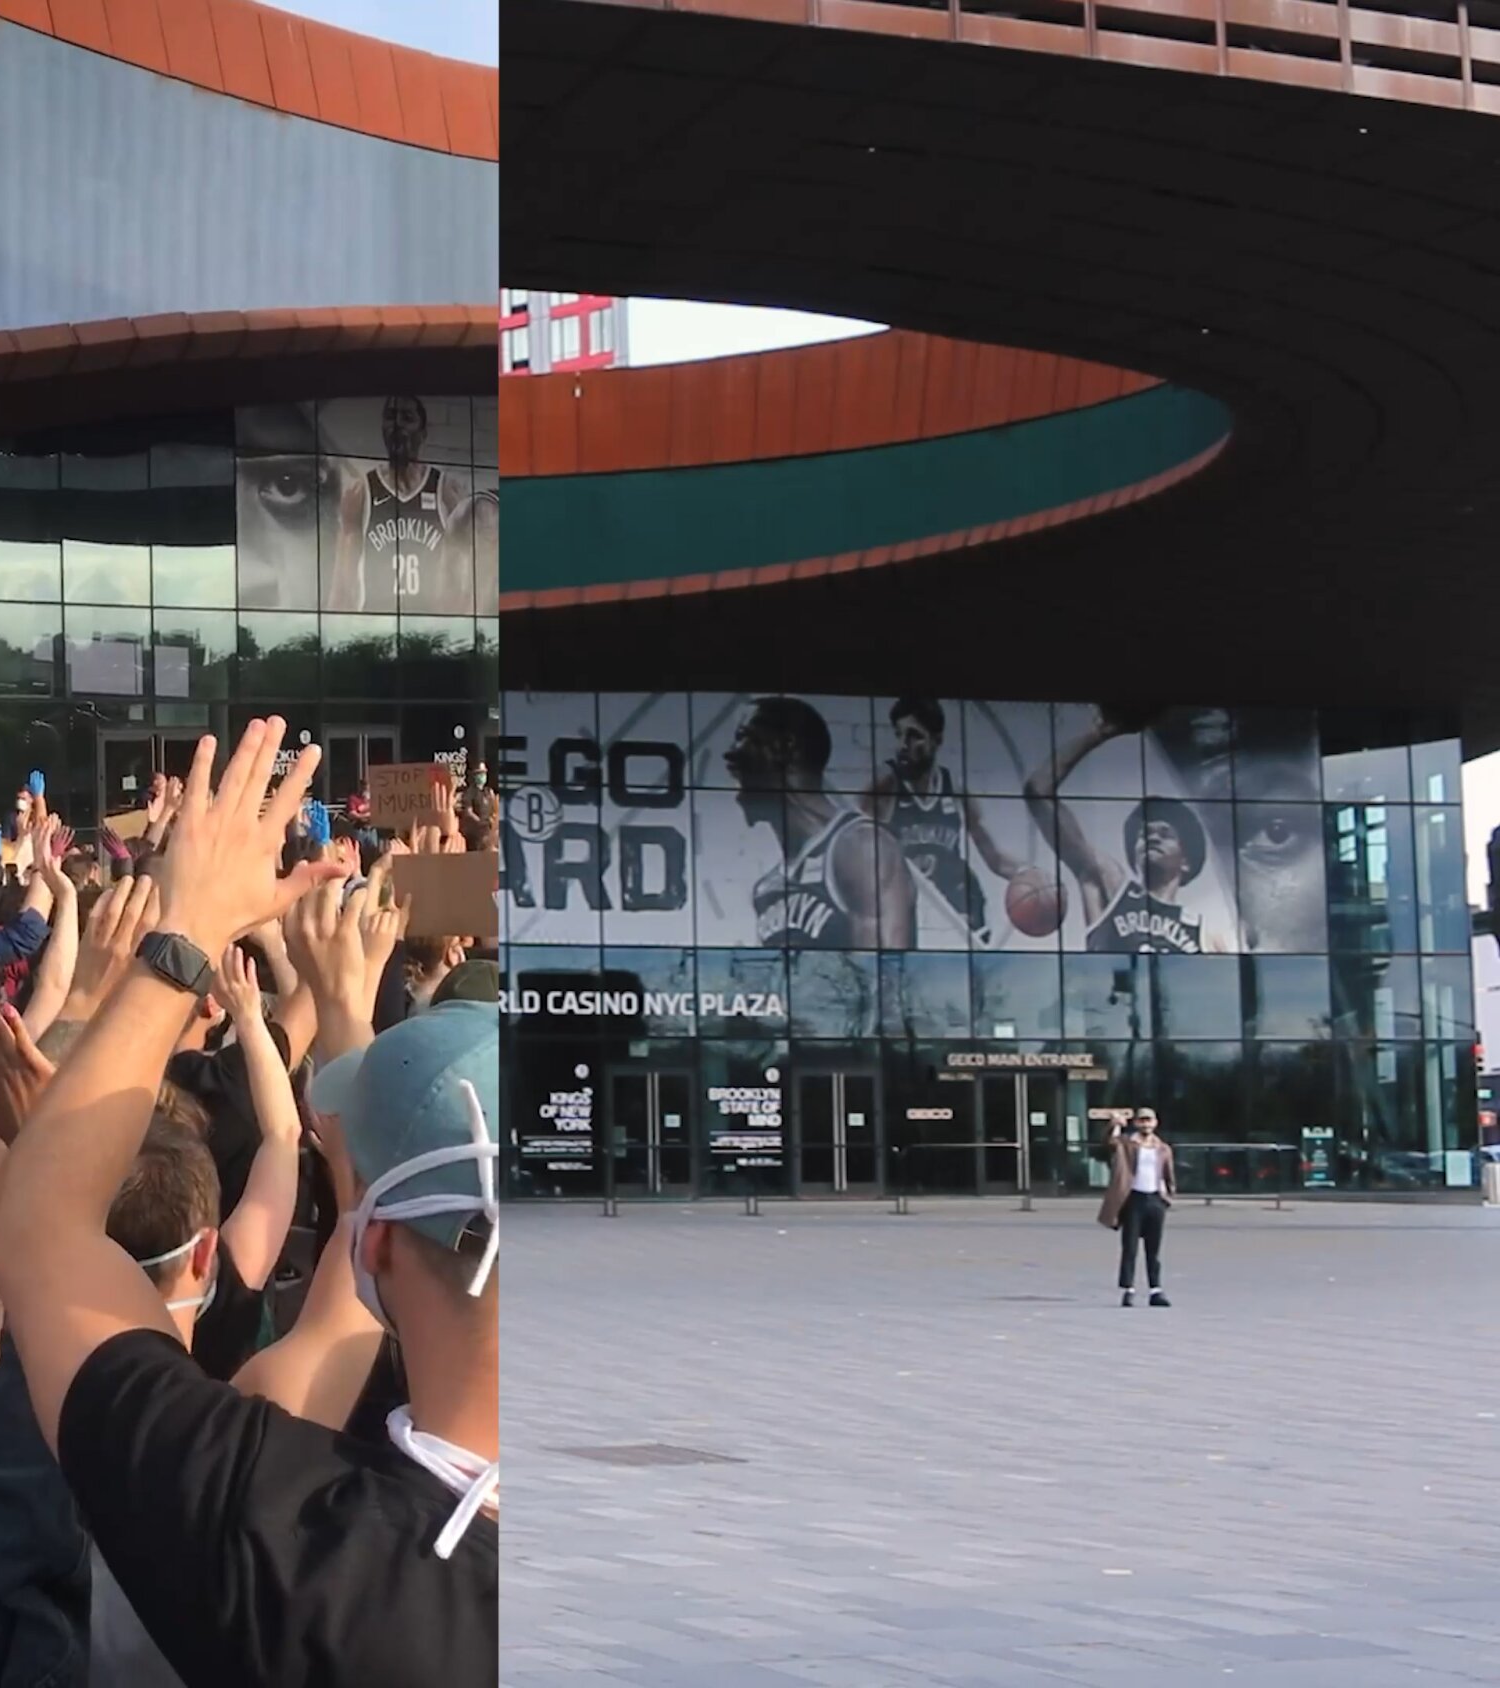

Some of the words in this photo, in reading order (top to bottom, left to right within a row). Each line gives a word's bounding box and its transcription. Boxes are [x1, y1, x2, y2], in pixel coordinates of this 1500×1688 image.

[368, 517, 442, 551] BROOKLYN
[392, 554, 420, 595] 26
[433, 751, 467, 763] KINGS
[376, 768, 423, 787] STOP
[377, 793, 432, 814] MURD
[547, 990, 638, 1015] CASINO
[643, 992, 695, 1016] NYC
[701, 993, 784, 1017] PLAZA
[988, 1054, 1022, 1066] MAIN
[1024, 1054, 1094, 1067] ENTRANCE
[549, 1091, 592, 1104] KINGS
[708, 1087, 781, 1100] BROOKLYN
[539, 1104, 559, 1118] OF
[761, 1100, 781, 1113] OF
[553, 1118, 592, 1131] YORK
